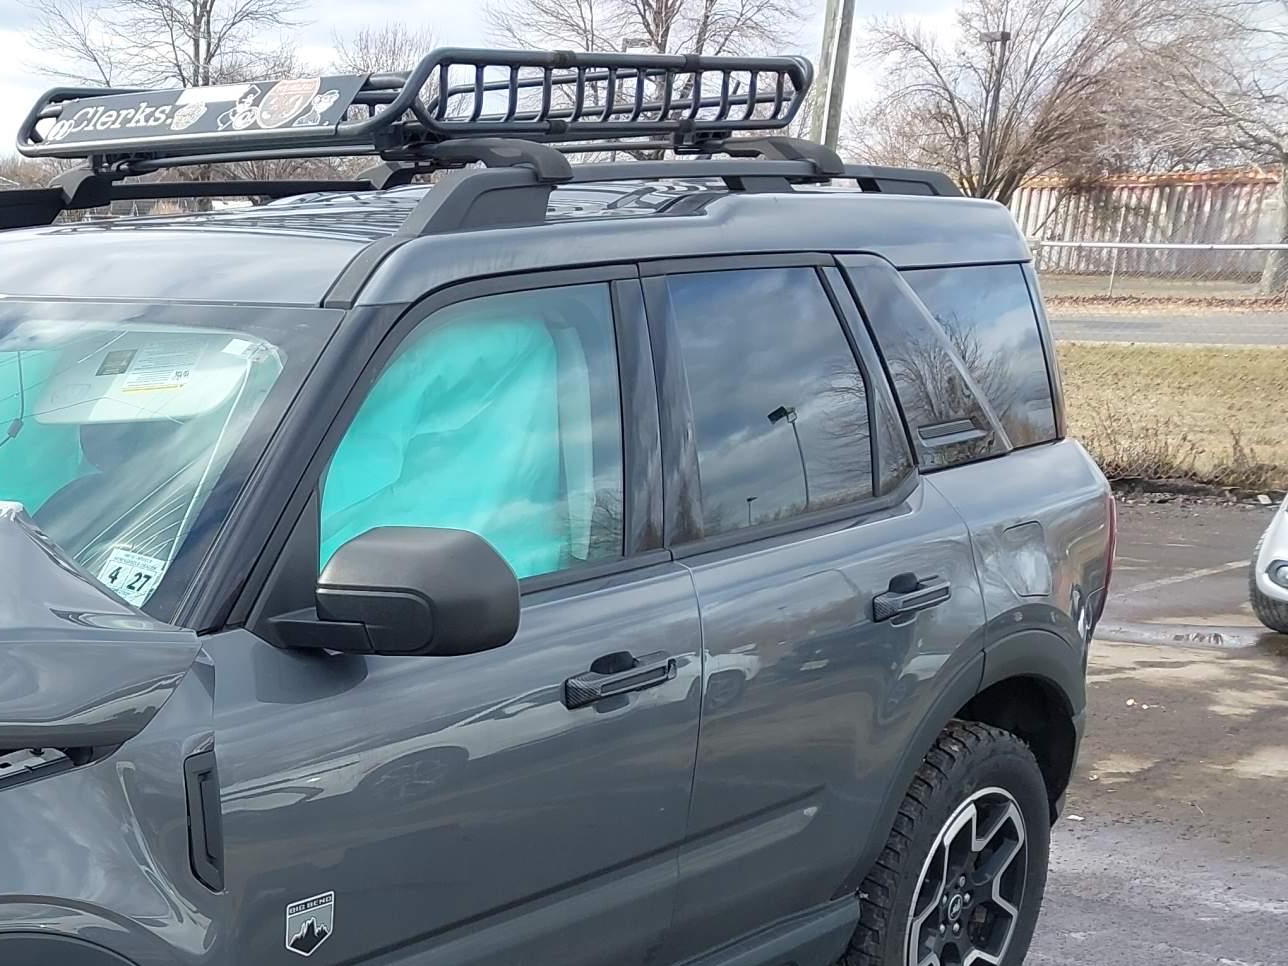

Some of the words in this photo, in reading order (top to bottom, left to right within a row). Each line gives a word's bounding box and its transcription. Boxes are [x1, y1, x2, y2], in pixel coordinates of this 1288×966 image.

[108, 566, 123, 584] 4
[127, 571, 152, 592] 27
[307, 896, 332, 908] BEND
